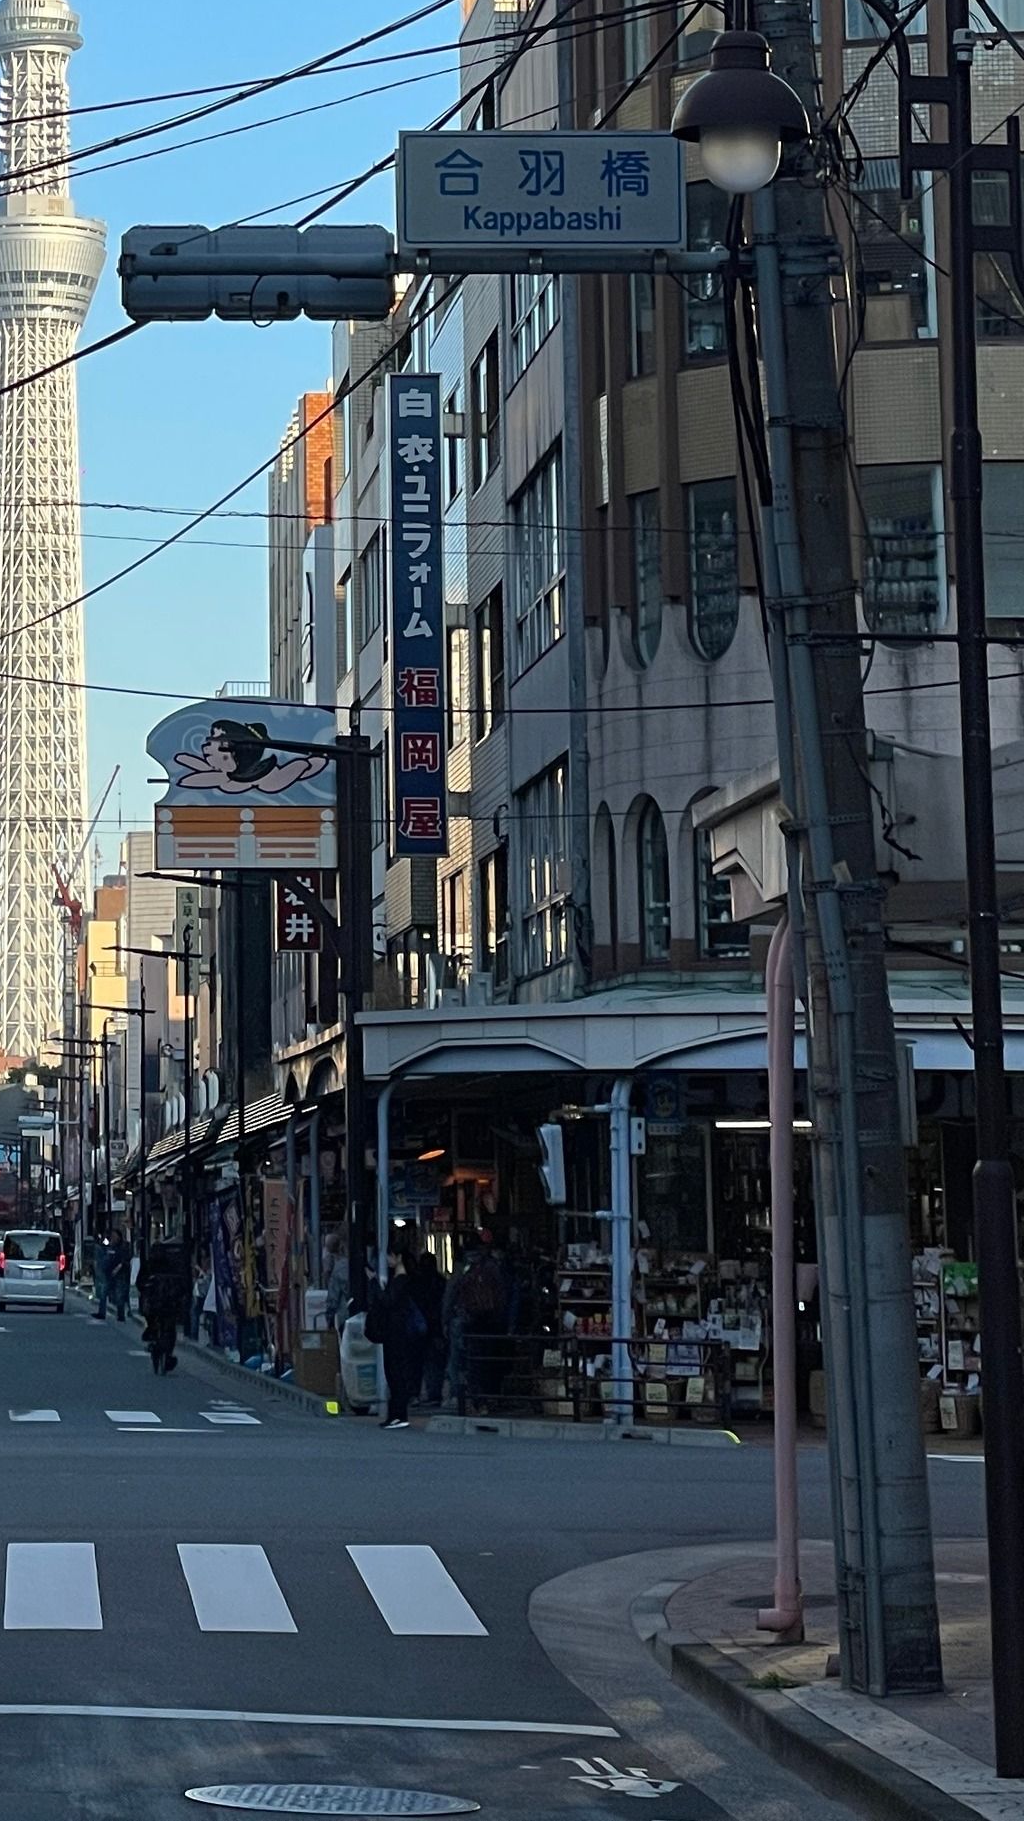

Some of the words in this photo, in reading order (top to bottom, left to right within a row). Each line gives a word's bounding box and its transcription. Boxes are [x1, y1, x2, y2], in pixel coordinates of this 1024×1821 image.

[435, 148, 651, 198] 合羽橋
[463, 204, 622, 237] Kappabashi
[396, 387, 434, 640] 白衣・ユニフォーム
[397, 667, 443, 840] 福岡屋
